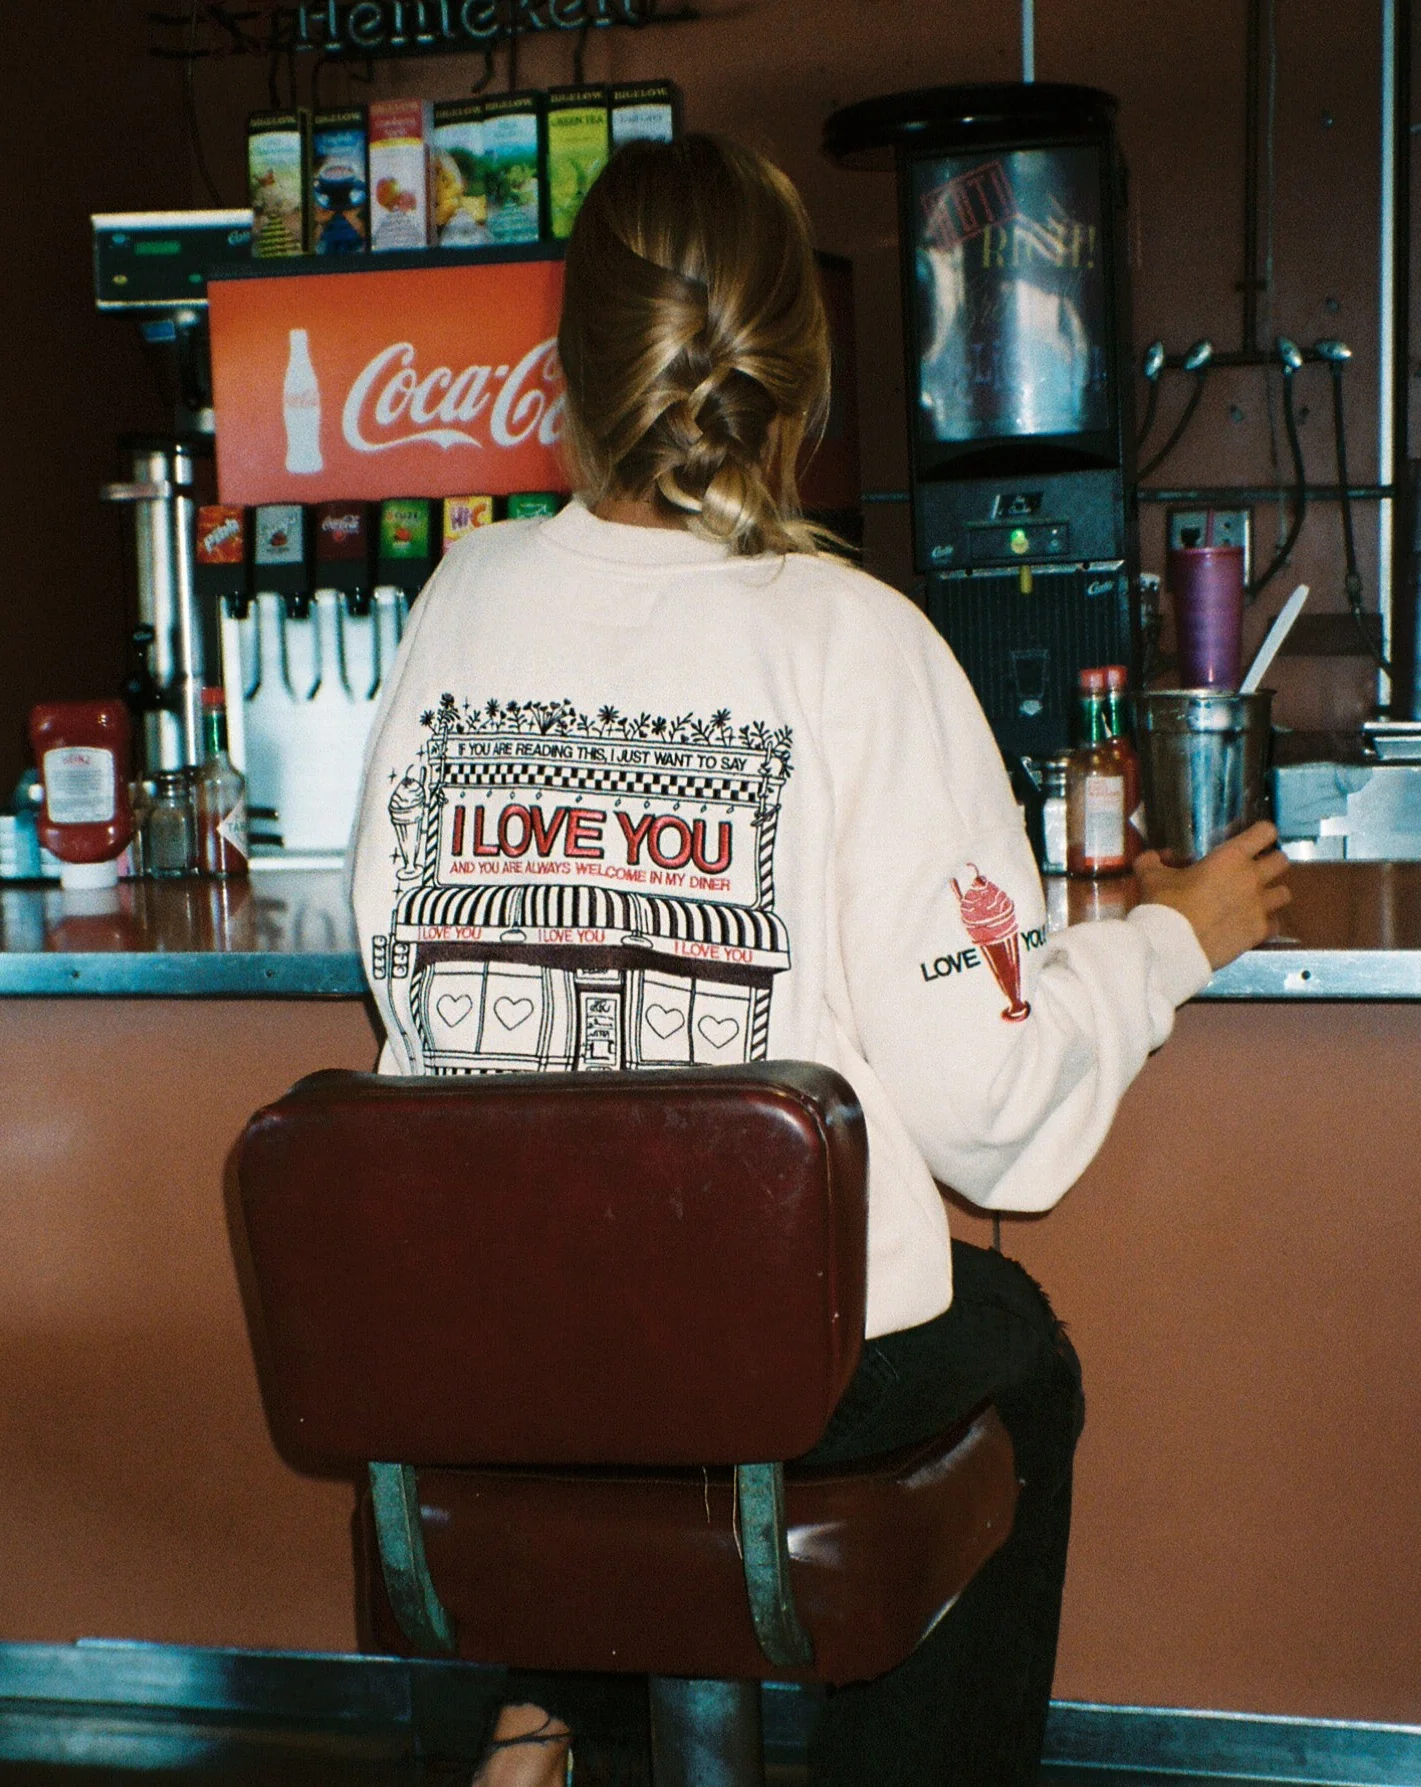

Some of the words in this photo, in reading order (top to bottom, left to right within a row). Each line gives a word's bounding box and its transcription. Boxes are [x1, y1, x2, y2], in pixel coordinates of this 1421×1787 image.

[342, 337, 566, 453] Coca-Co
[458, 743, 466, 756] IF
[469, 743, 491, 756] YOU
[492, 742, 513, 755] ARE
[515, 743, 573, 758] READING
[576, 746, 607, 763] THIS,
[617, 750, 650, 764] JUST
[654, 751, 693, 767] WANT
[697, 754, 717, 769] TO
[720, 757, 748, 771] SAY
[451, 805, 466, 857] I
[473, 803, 607, 858] LOVE
[612, 810, 732, 875] YOU
[450, 862, 475, 874] AND
[477, 862, 500, 874] YOU
[502, 862, 523, 874] ARE
[525, 861, 571, 874] ALWAYS
[575, 862, 647, 883] WELCOME
[650, 871, 663, 885] IN
[665, 872, 686, 886] MY
[689, 876, 731, 891] DINER
[422, 926, 451, 940] LOVE
[455, 926, 482, 940] YOU
[543, 929, 573, 943] LOVE
[576, 929, 605, 943] YOU
[681, 942, 720, 960] LOVE
[724, 946, 753, 963] YOU
[920, 948, 981, 982] LOVE
